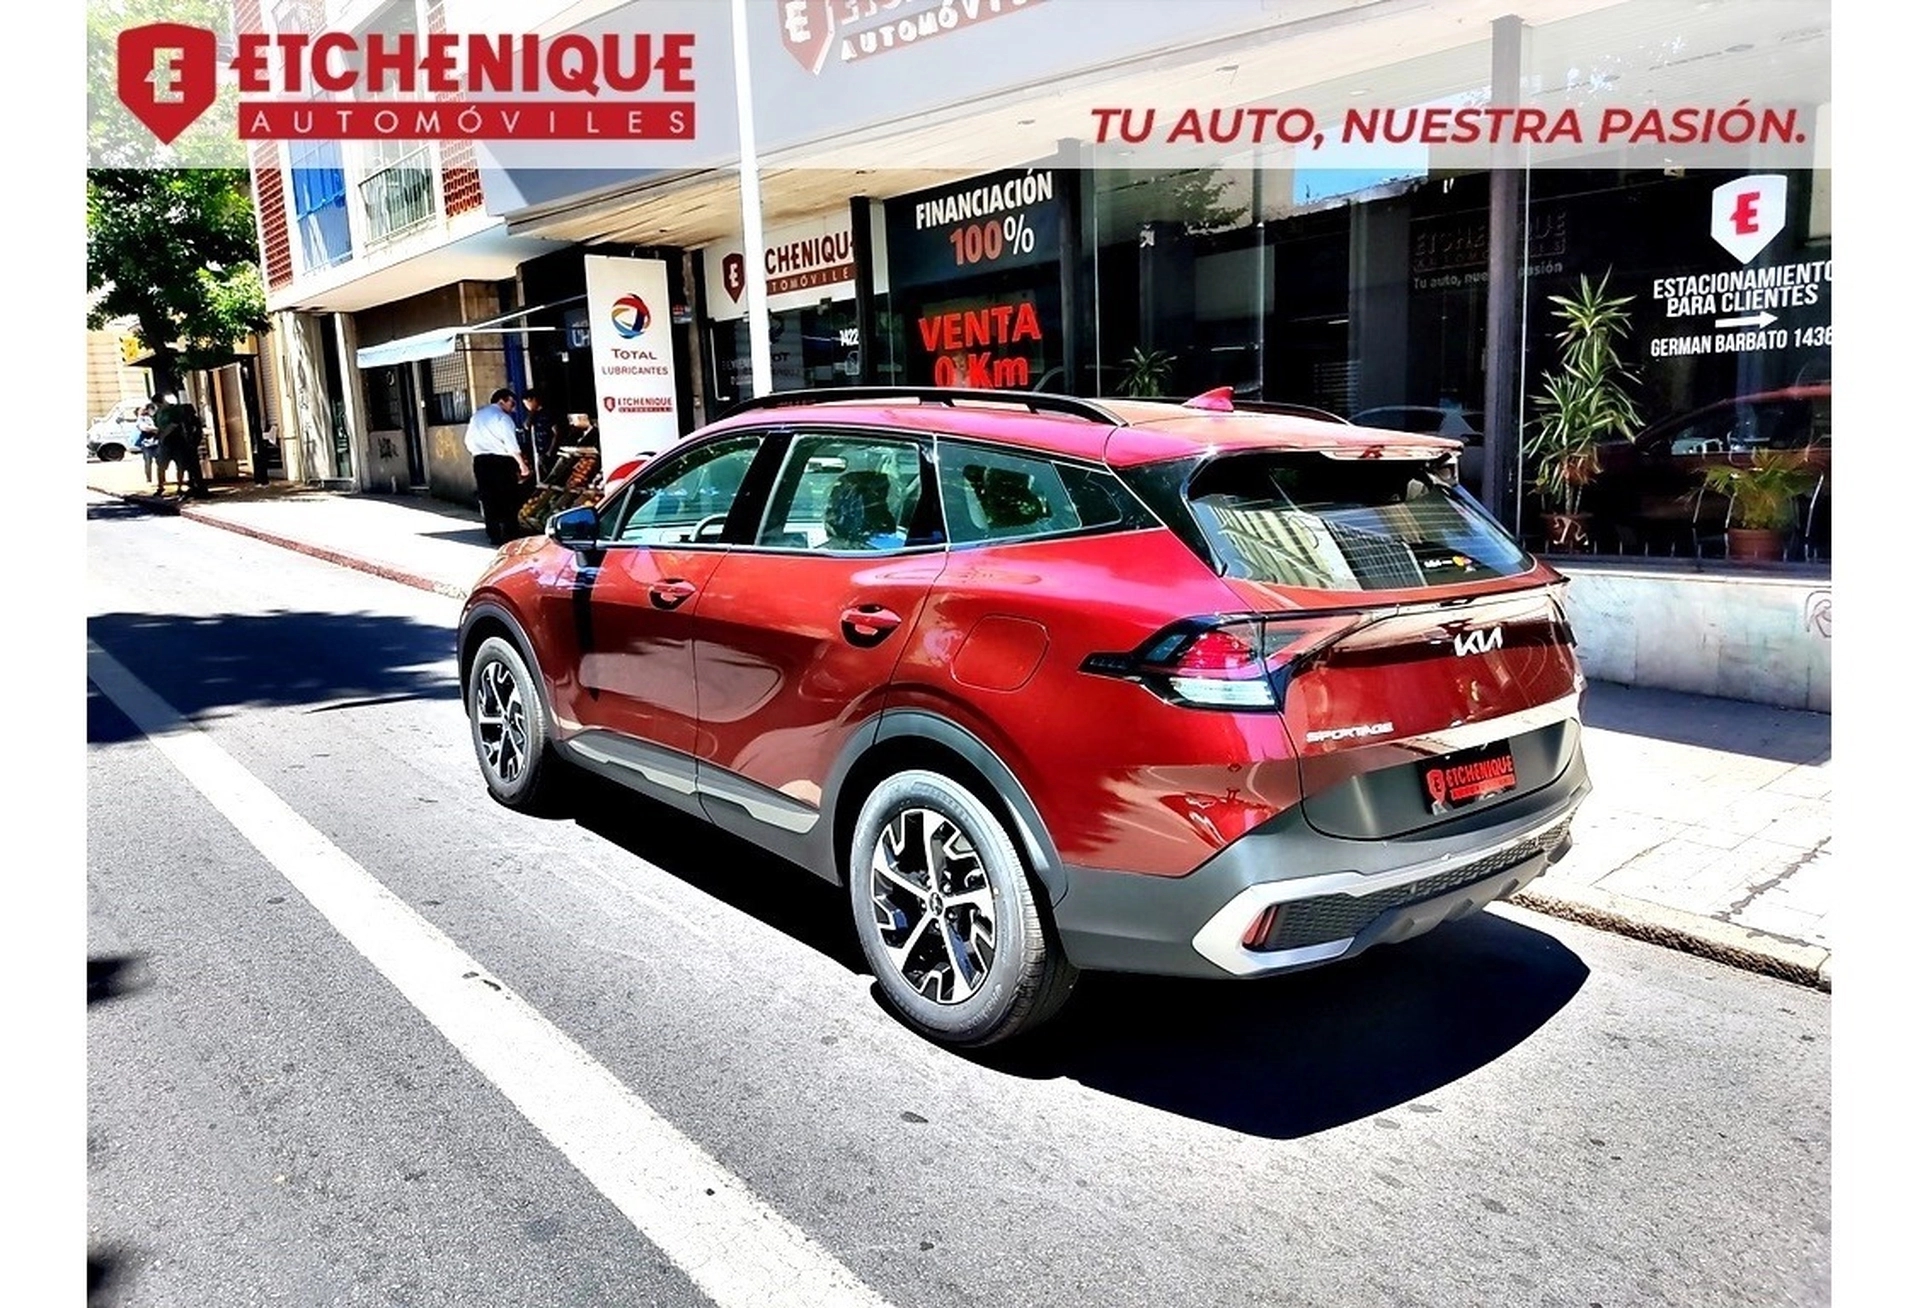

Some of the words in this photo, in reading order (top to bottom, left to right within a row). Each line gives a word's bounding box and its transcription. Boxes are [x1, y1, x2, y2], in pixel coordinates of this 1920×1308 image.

[915, 168, 1052, 230] FINANCIACIÓN
[764, 231, 853, 275] CHENIQU
[951, 214, 1035, 266] 100%
[772, 267, 848, 292] TOMÓVILE
[1653, 260, 1831, 299] ESTACIONAMIENTO
[1666, 293, 1716, 317] PARA
[1721, 283, 1818, 312] CLIENTES
[918, 303, 1042, 352] VENTA
[1650, 335, 1711, 357] GERMAN
[1715, 329, 1787, 353] BARBATO
[602, 366, 669, 375] LUBRICANTES
[935, 356, 956, 388] 0
[967, 352, 1028, 388] Km
[618, 397, 673, 406] ETCHENIQUE
[1454, 626, 1503, 657] KIA
[1446, 755, 1514, 787] ETCHENIQUE
